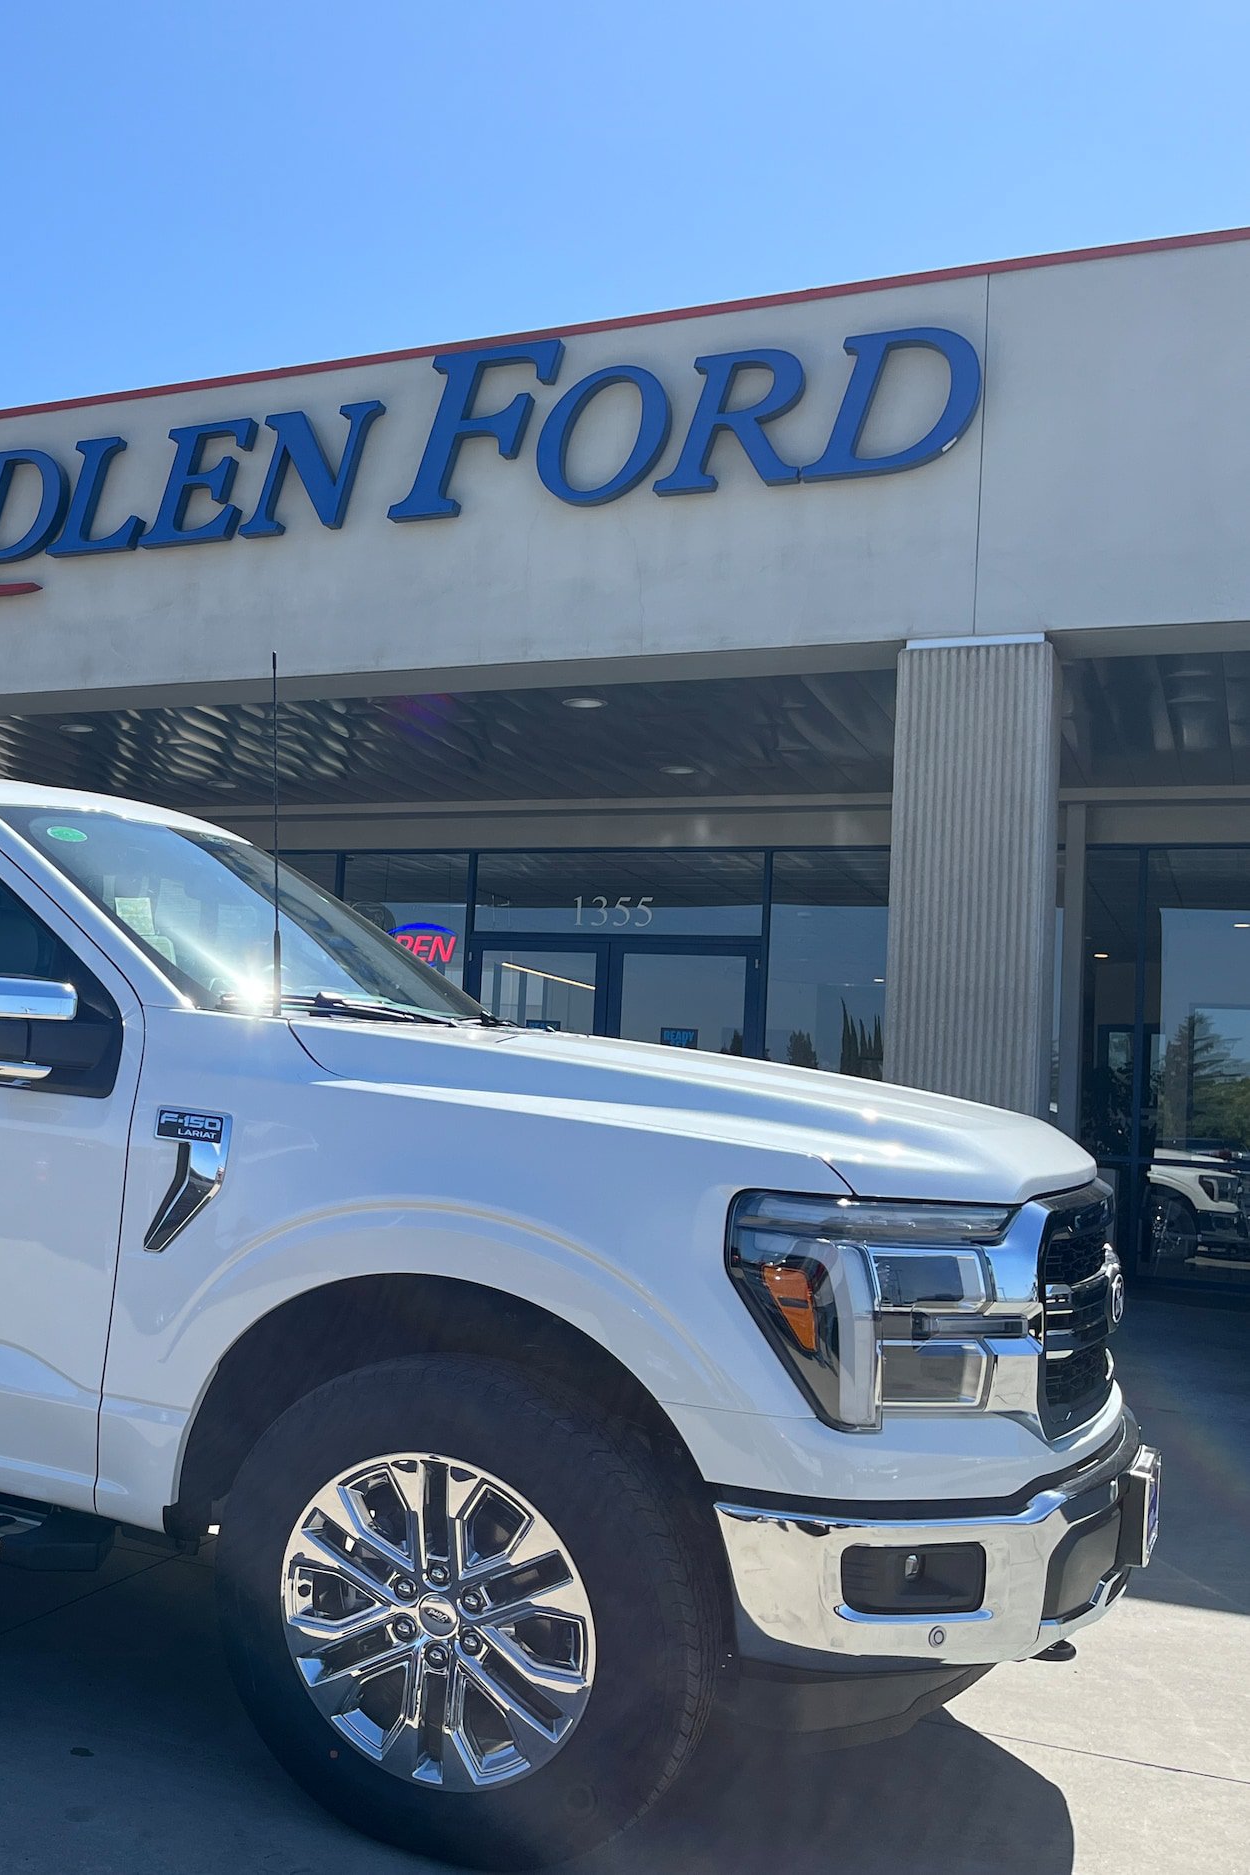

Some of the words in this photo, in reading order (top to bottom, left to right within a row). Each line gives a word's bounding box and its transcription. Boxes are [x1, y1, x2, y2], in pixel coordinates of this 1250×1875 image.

[387, 326, 983, 524] FORD
[572, 895, 654, 928] 1355
[395, 934, 457, 963] PEN
[663, 1030, 695, 1042] READY
[160, 1112, 221, 1131] F-150
[177, 1128, 217, 1139] LARIAT
